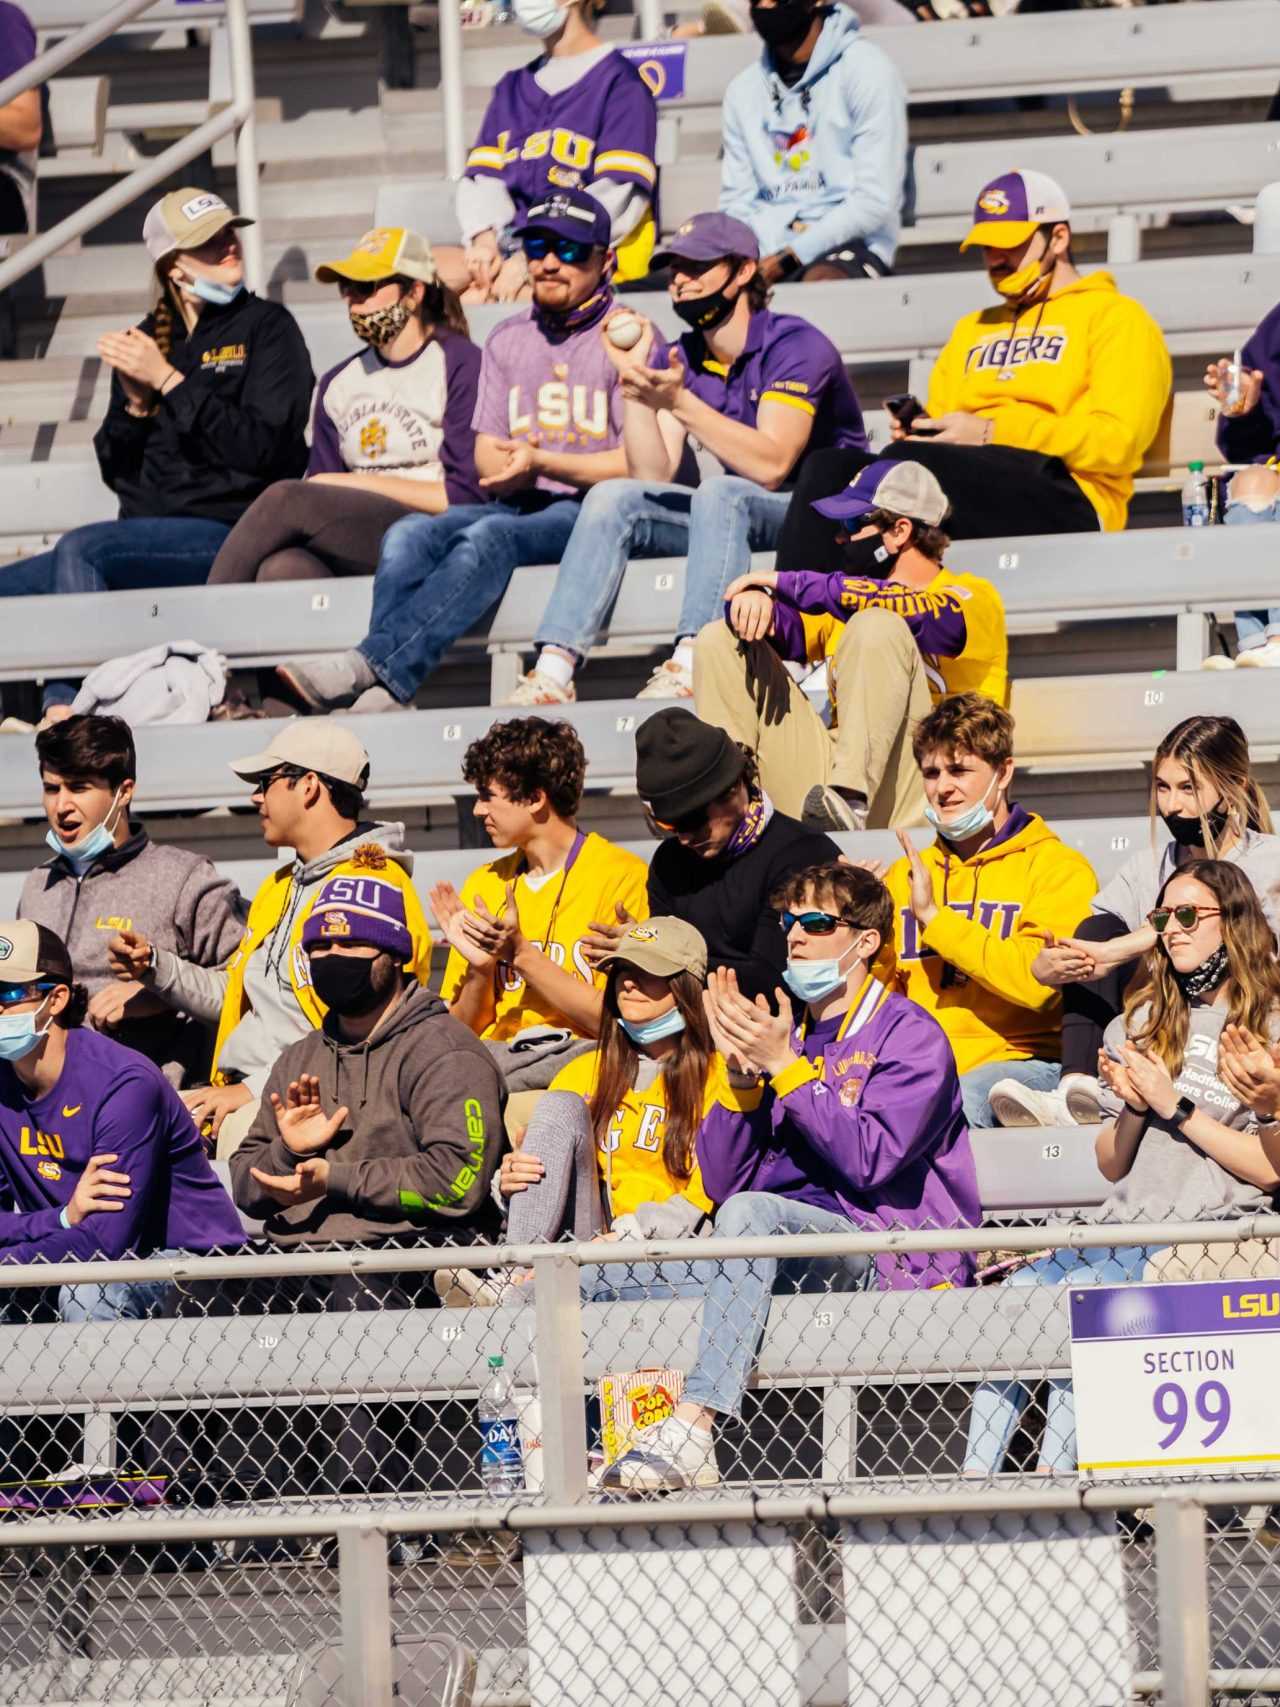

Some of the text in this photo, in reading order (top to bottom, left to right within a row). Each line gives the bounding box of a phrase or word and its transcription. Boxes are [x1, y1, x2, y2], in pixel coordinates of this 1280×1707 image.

[497, 128, 596, 171] LSU
[964, 335, 1066, 376] TIGERS
[508, 381, 609, 440] LSU
[1146, 690, 1159, 704] 10
[1112, 836, 1125, 849] 11
[314, 876, 381, 910] LSU
[96, 916, 133, 931] LSU
[321, 922, 351, 937] LSU
[1043, 1144, 1058, 1159] 13
[1221, 1293, 1280, 1320] LSU
[1142, 1348, 1236, 1376] SECTION
[636, 1392, 666, 1415] POP
[1151, 1379, 1233, 1451] 99
[635, 1405, 673, 1431] CORN
